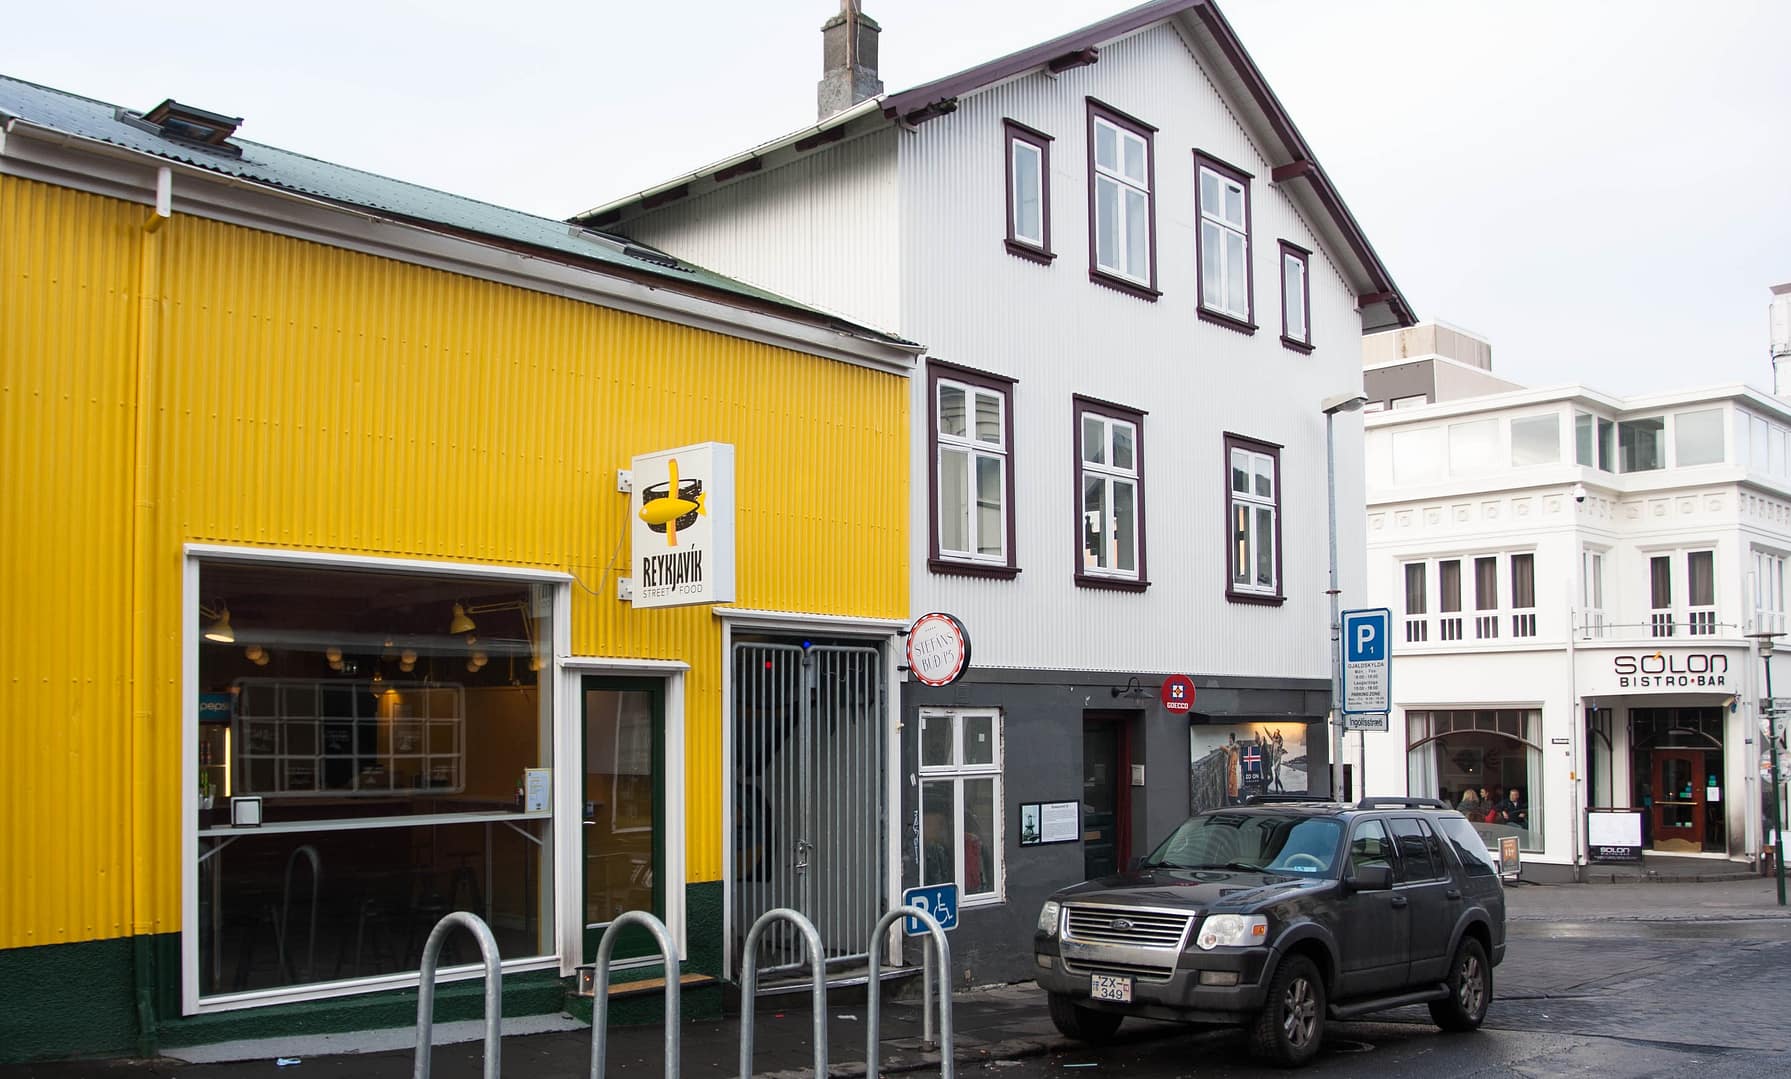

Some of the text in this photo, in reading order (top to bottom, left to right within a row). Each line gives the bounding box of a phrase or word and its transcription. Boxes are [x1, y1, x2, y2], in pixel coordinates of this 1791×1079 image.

[642, 543, 703, 592] REYKJAVÍK
[642, 584, 703, 599] STREET FOOD
[914, 631, 954, 656] STEFÁNS
[1357, 624, 1375, 654] P
[1697, 675, 1725, 686] BAR
[200, 702, 229, 713] peps
[1101, 988, 1123, 999] 349
